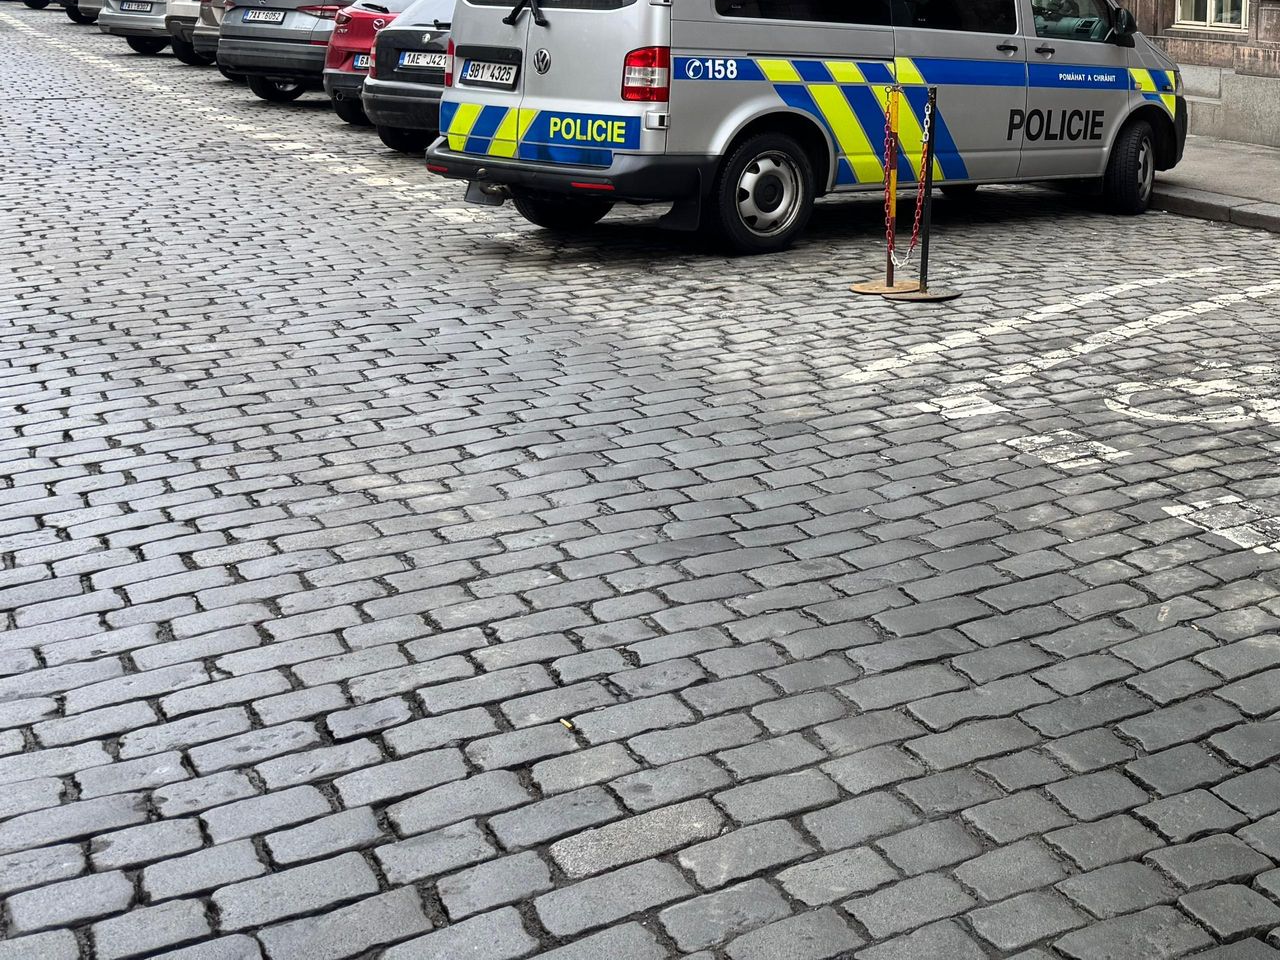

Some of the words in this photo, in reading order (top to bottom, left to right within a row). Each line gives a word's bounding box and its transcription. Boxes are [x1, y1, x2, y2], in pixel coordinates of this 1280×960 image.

[407, 53, 421, 64] 1AE
[469, 63, 486, 79] 9B1
[489, 65, 513, 82] 4325
[705, 59, 738, 79] 158
[1058, 72, 1086, 81] POMÁHAT
[550, 117, 626, 143] POLICIE
[1007, 109, 1104, 141] POLICIE
